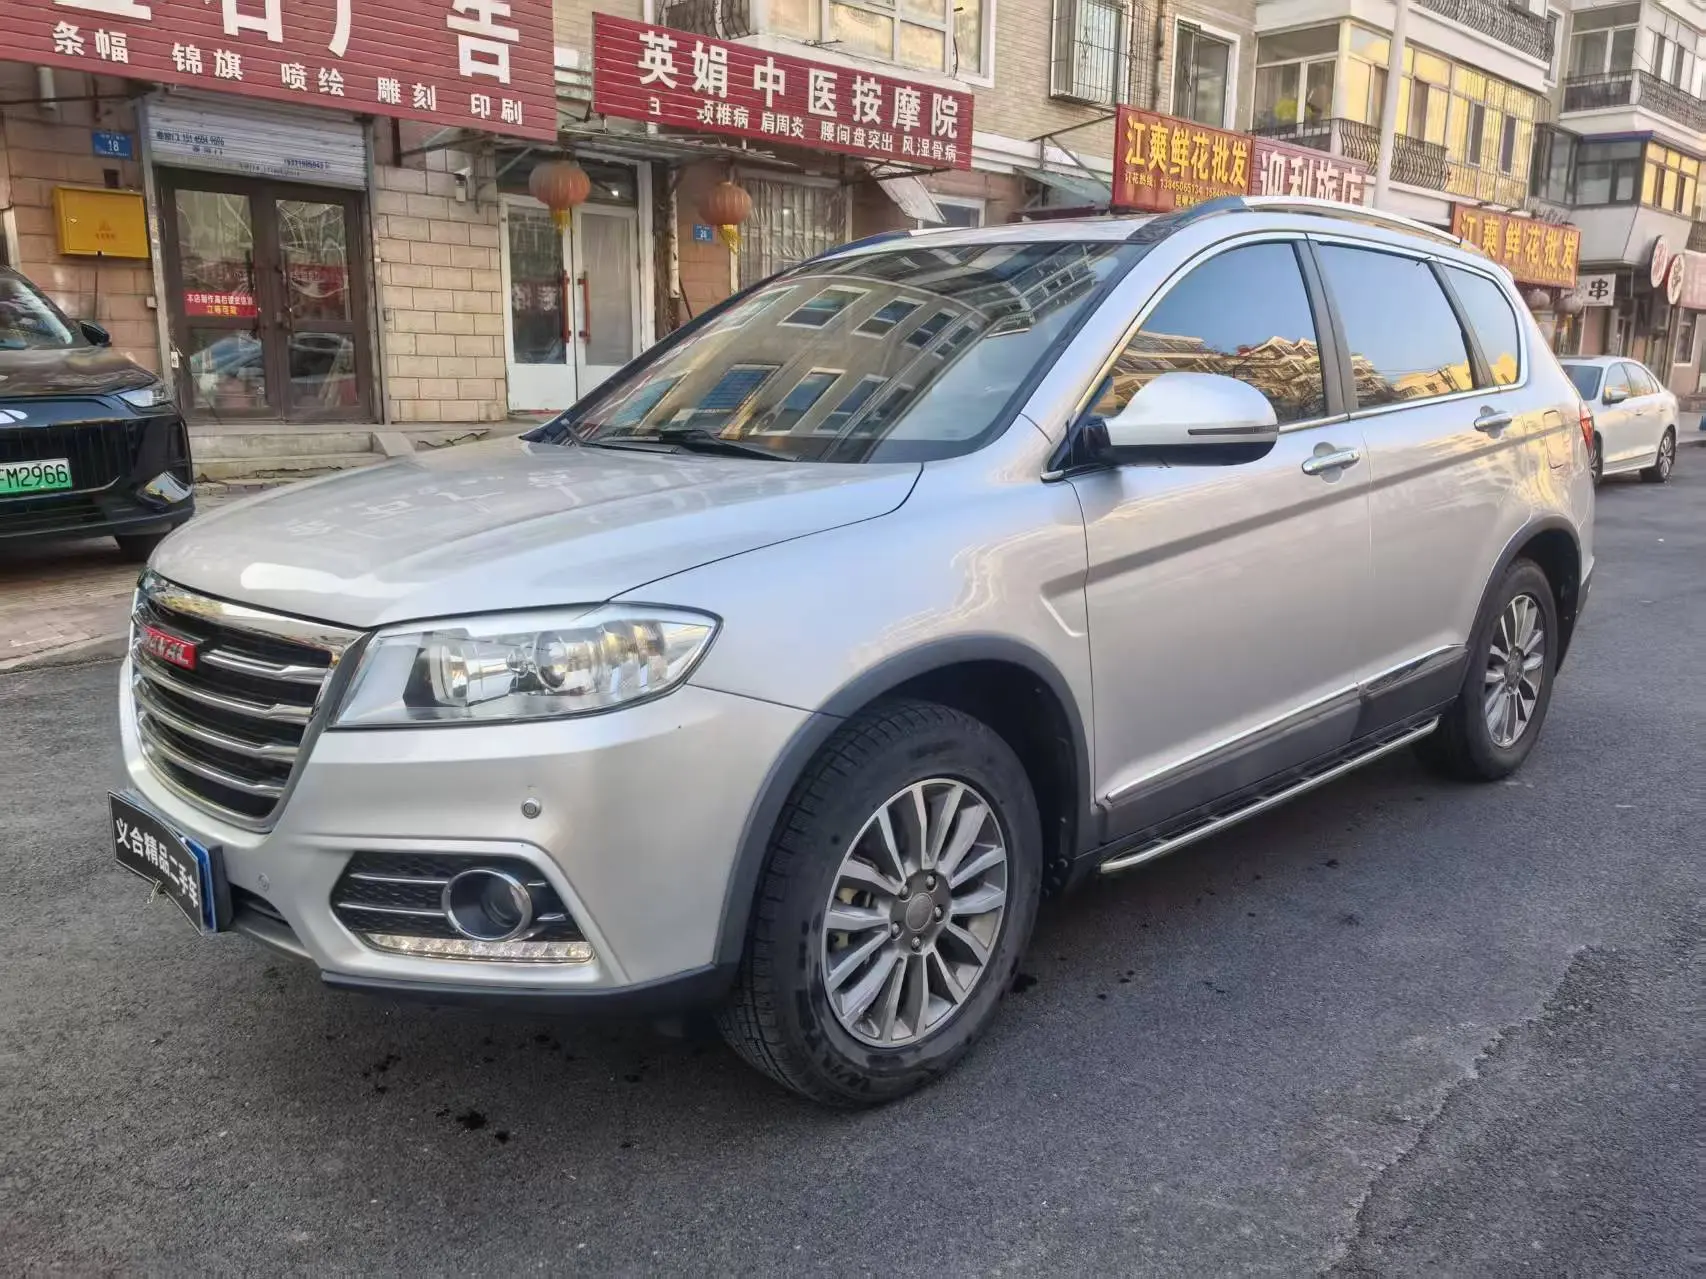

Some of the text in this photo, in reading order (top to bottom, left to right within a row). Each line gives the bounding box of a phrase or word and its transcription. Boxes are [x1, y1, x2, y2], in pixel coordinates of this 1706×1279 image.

[53, 20, 523, 125] 条幅 锦旗 喷绘 雕刻 印刷
[638, 30, 959, 139] 英娟中医按摩院
[760, 111, 805, 139] 肩周炎
[820, 120, 893, 153] 腰间盘突出
[902, 135, 957, 163] 风湿骨病
[1125, 115, 1248, 188] 江爽鲜花批发
[1460, 210, 1577, 270] 江爽鲜花批发
[1588, 278, 1609, 300] 串
[116, 817, 199, 908] 义合精品二手车
